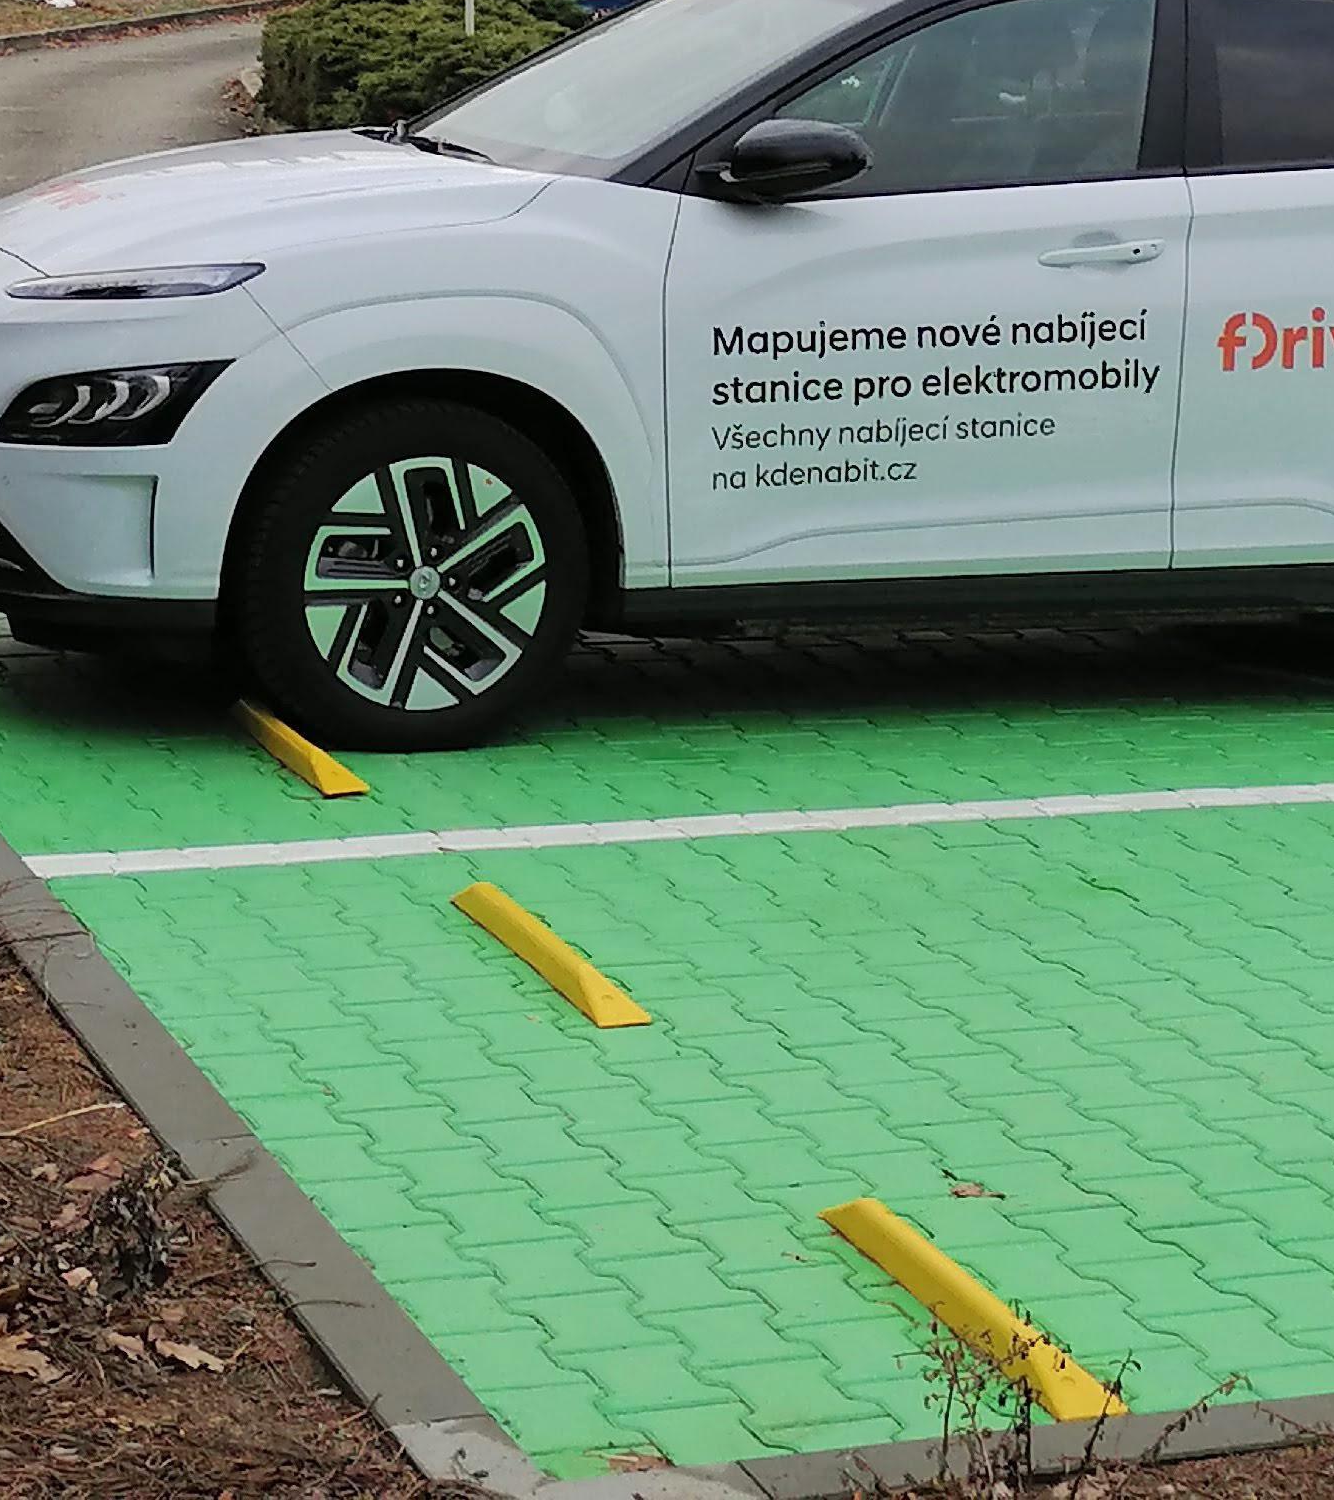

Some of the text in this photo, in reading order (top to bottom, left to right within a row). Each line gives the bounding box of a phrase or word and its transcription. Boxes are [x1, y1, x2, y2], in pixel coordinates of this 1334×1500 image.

[713, 308, 1148, 361] Mapujeme nové nabíjecí
[712, 358, 1161, 407] stanice pro elektromobily
[712, 411, 1056, 451] Všechny nabíjecí stanice
[712, 456, 918, 491] na kdenabit.cz
